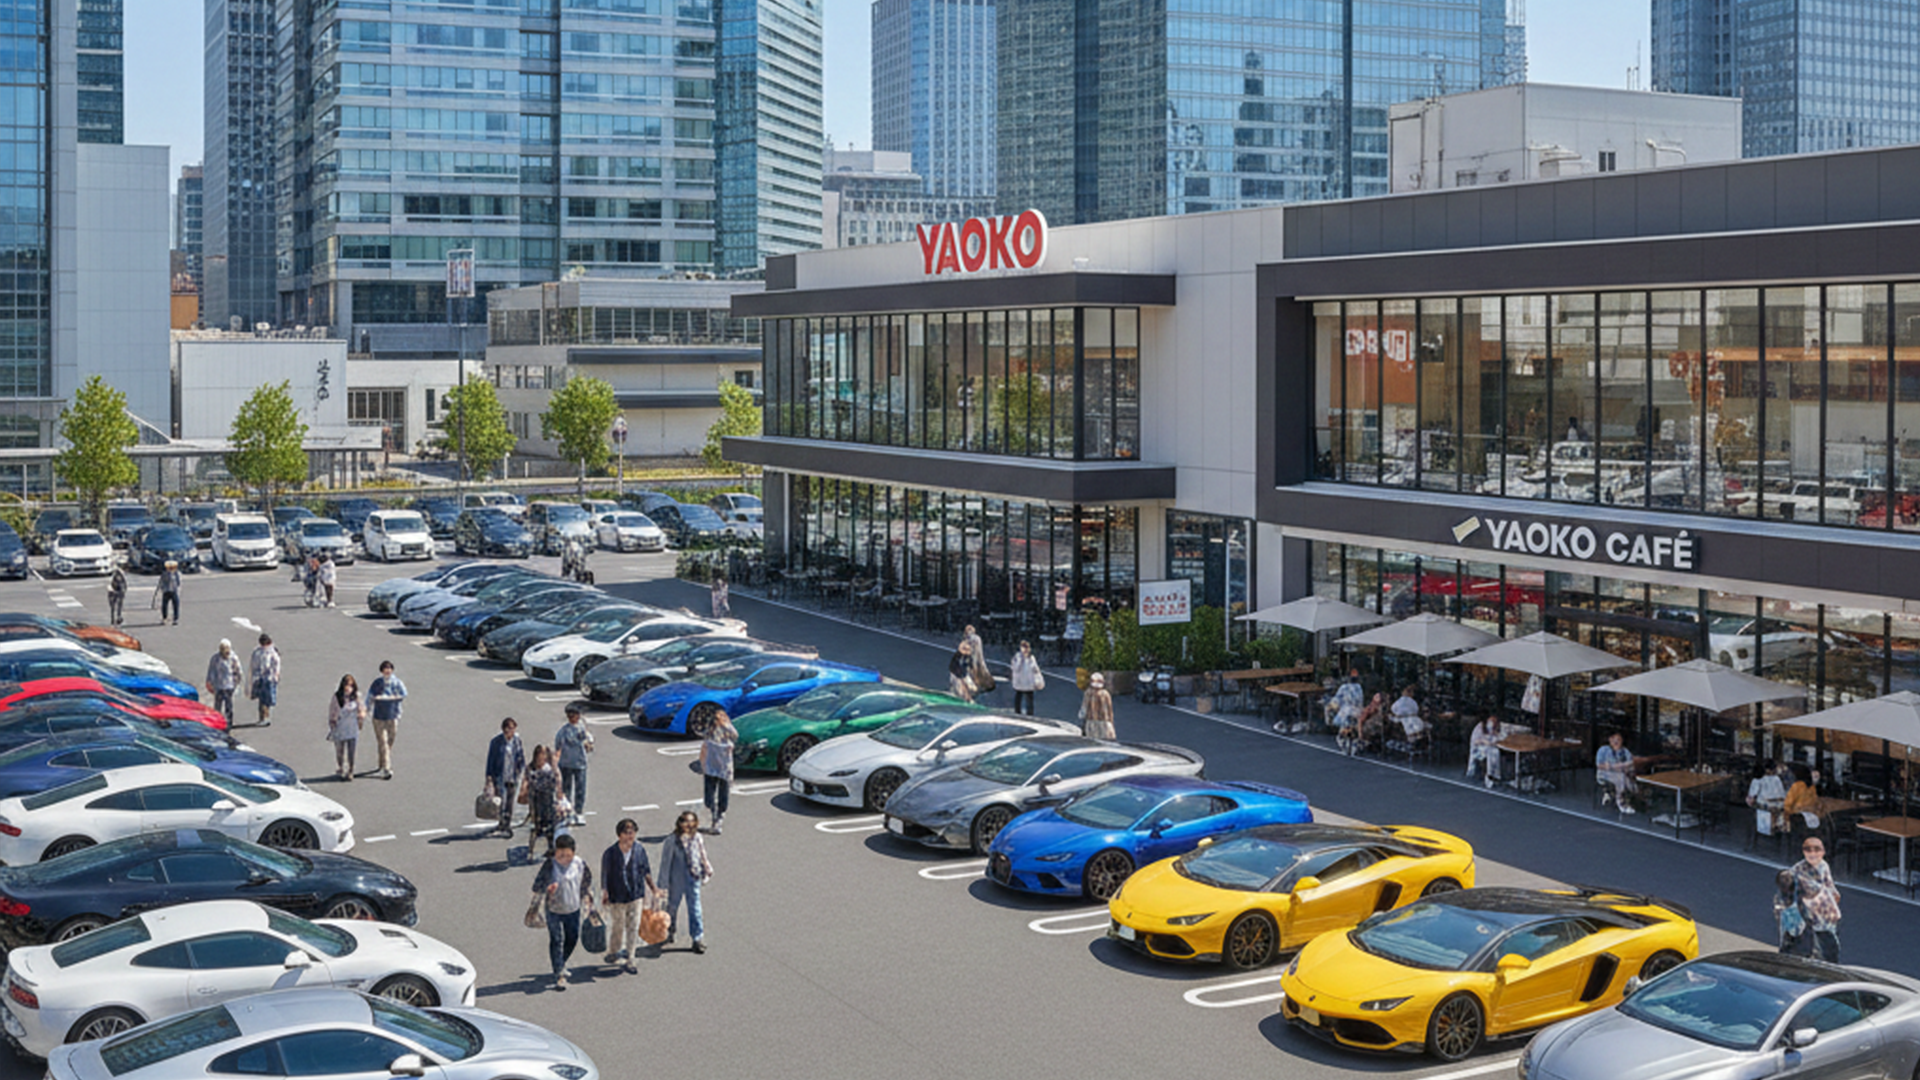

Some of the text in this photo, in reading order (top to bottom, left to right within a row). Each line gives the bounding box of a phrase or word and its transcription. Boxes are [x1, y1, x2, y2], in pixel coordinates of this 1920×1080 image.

[916, 209, 1046, 275] YAOKO
[1485, 518, 1693, 569] YAOKO CAFÉ
